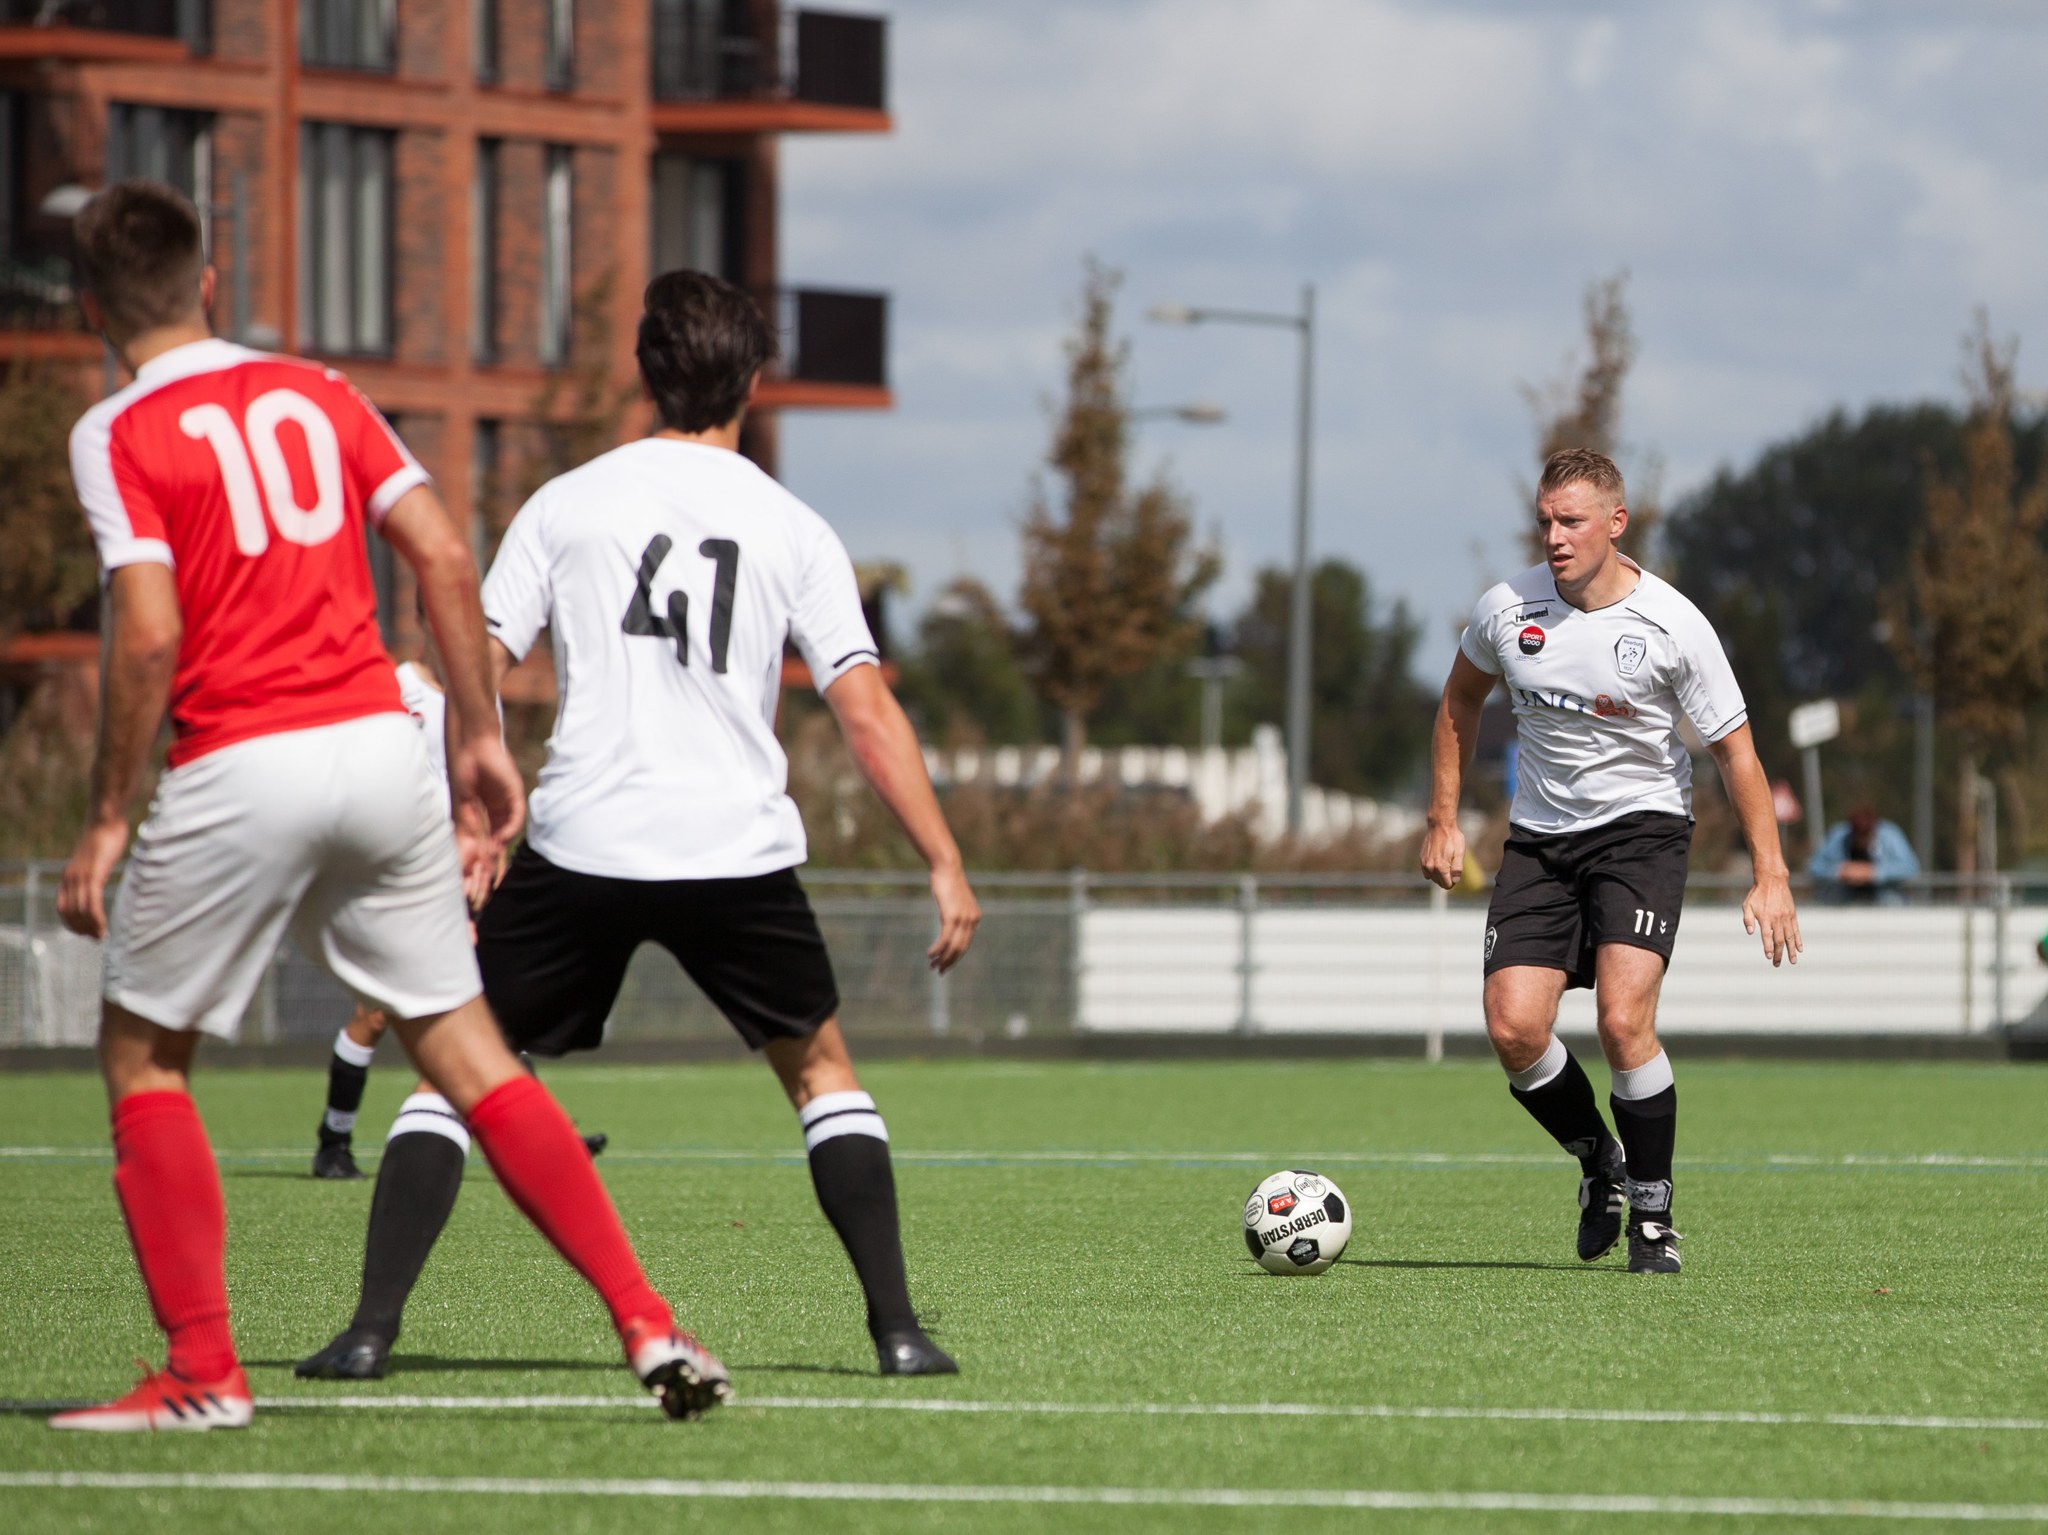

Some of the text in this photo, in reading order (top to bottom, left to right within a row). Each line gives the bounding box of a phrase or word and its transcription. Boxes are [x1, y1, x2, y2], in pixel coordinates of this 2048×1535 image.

[180, 389, 343, 556] 10
[621, 533, 739, 674] 41
[1516, 607, 1549, 622] hummel
[1522, 632, 1544, 641] SPORT
[1522, 638, 1541, 647] 2000
[1518, 688, 1586, 713] ING
[1634, 908, 1655, 936] 11
[1261, 1208, 1327, 1246] DERBYSTAR
